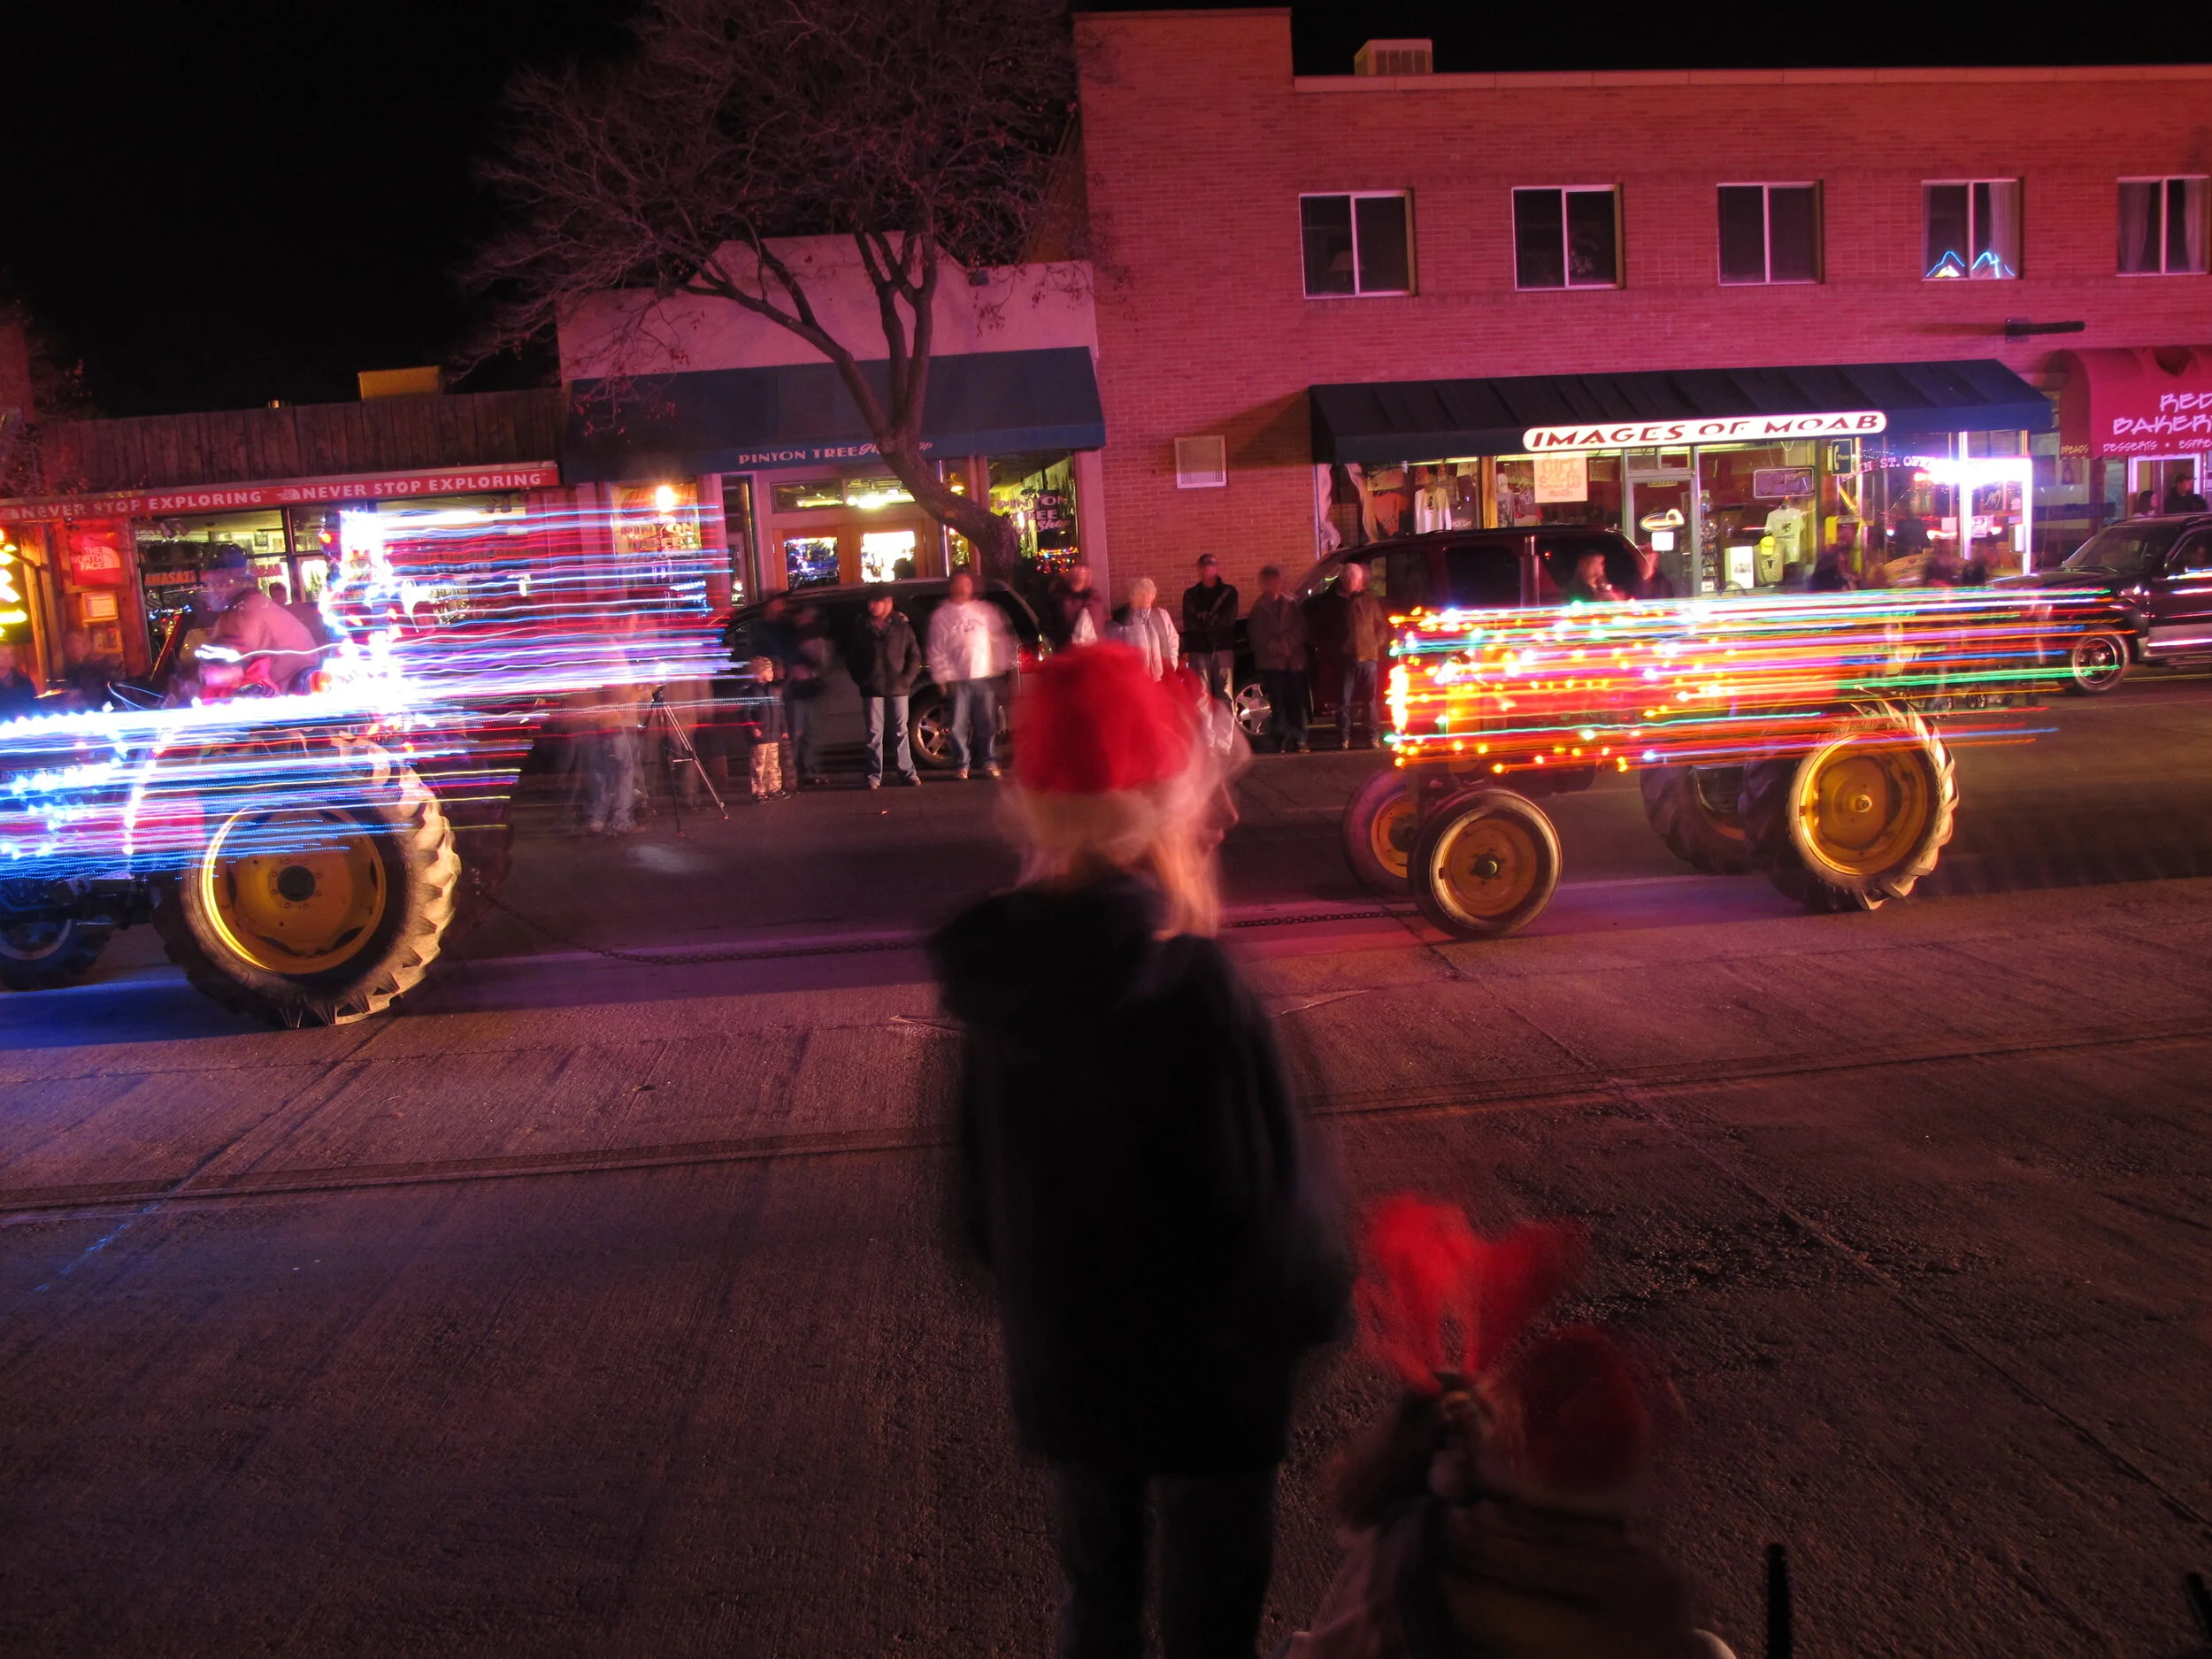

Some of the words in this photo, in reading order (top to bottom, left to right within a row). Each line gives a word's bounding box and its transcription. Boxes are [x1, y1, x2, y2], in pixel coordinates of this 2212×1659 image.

[2160, 393, 2212, 411] RED
[1532, 424, 1686, 447] IMAGES
[1699, 420, 1751, 436] OF
[1763, 415, 1878, 434] MOAB
[2113, 414, 2212, 435] BAKER
[739, 450, 806, 465] PINYON
[811, 446, 858, 459] TREE
[2102, 441, 2158, 452] DESSERTS
[303, 483, 366, 499] NEVER
[374, 480, 421, 495] STOP
[428, 473, 541, 490] EXPLORING
[22, 503, 88, 519] NEVER
[149, 491, 262, 511] EXPLORING
[72, 555, 104, 564] NORTH
[81, 561, 104, 571] FACE
